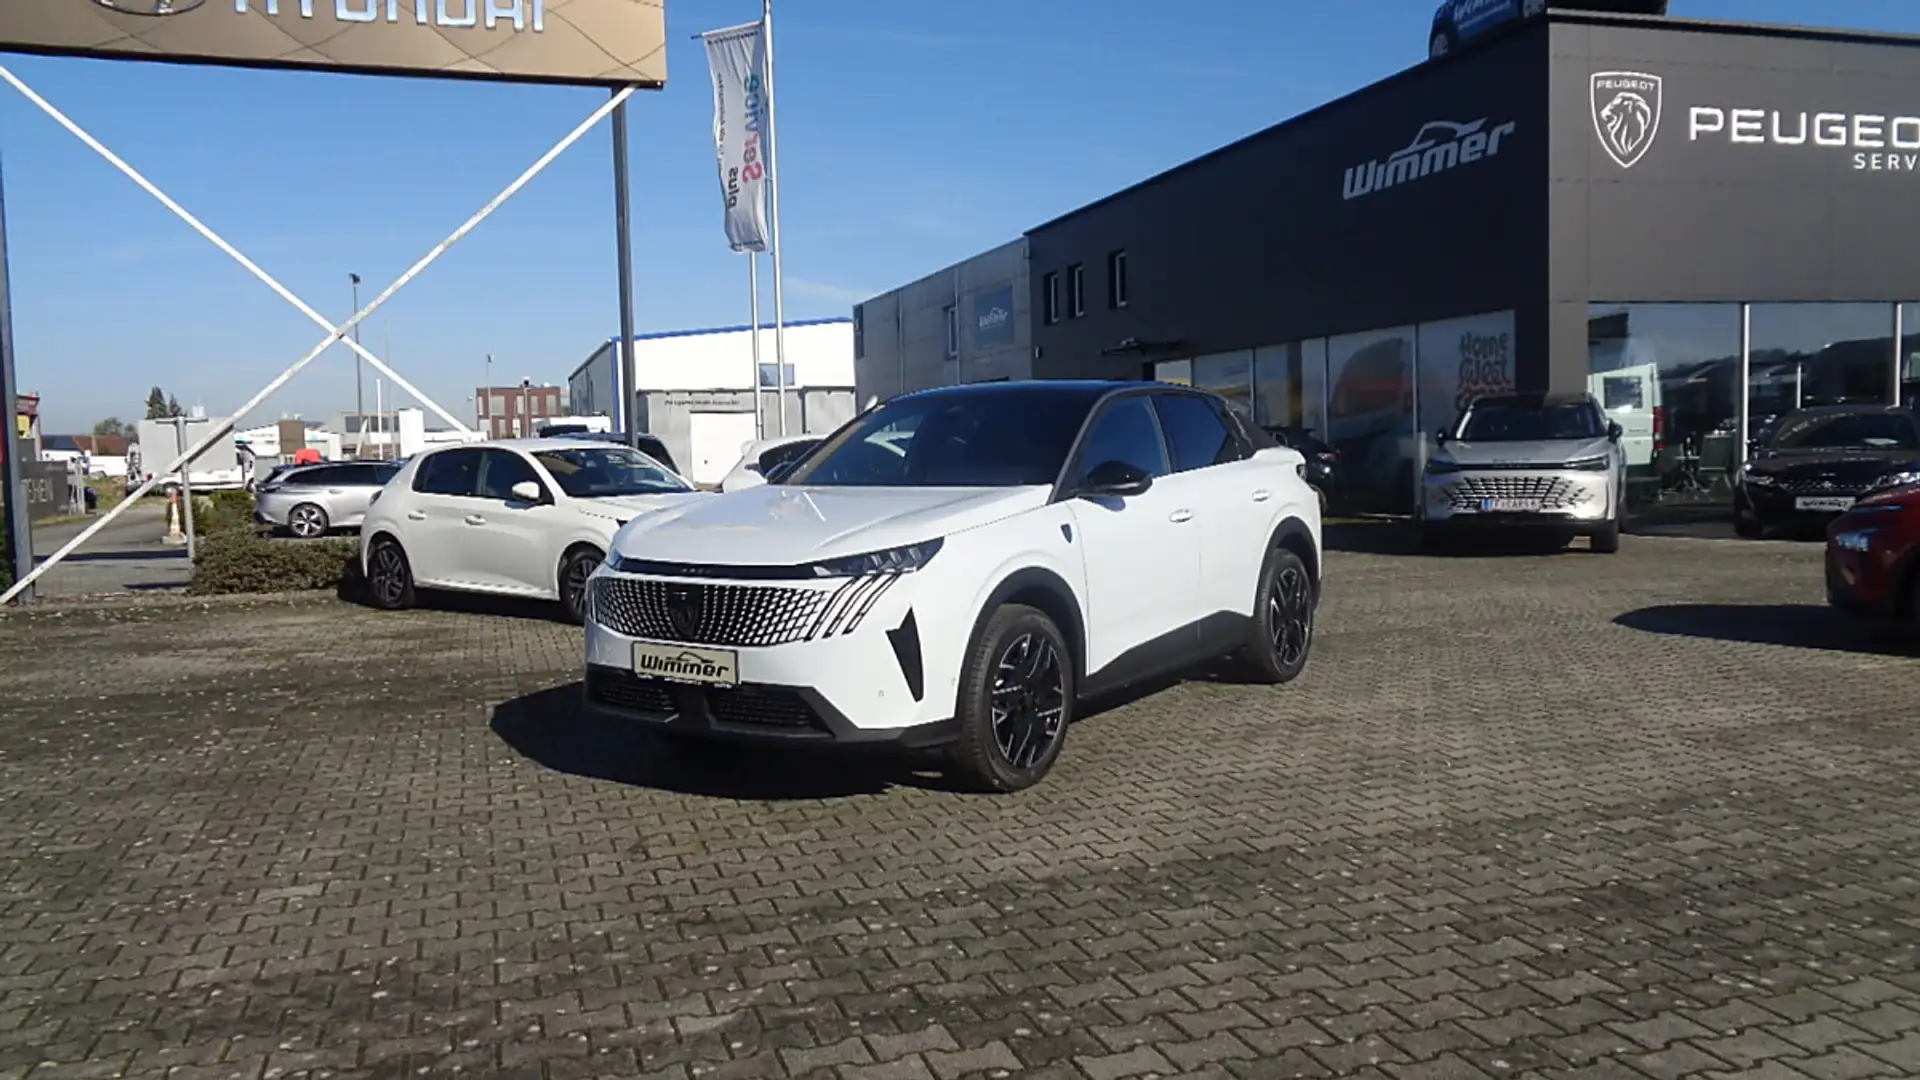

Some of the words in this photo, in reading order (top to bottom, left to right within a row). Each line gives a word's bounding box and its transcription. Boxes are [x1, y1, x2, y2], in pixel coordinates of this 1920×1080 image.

[1596, 78, 1655, 91] PEUGEOT
[1343, 120, 1515, 200] Wimmer
[641, 653, 729, 677] Wimmer
